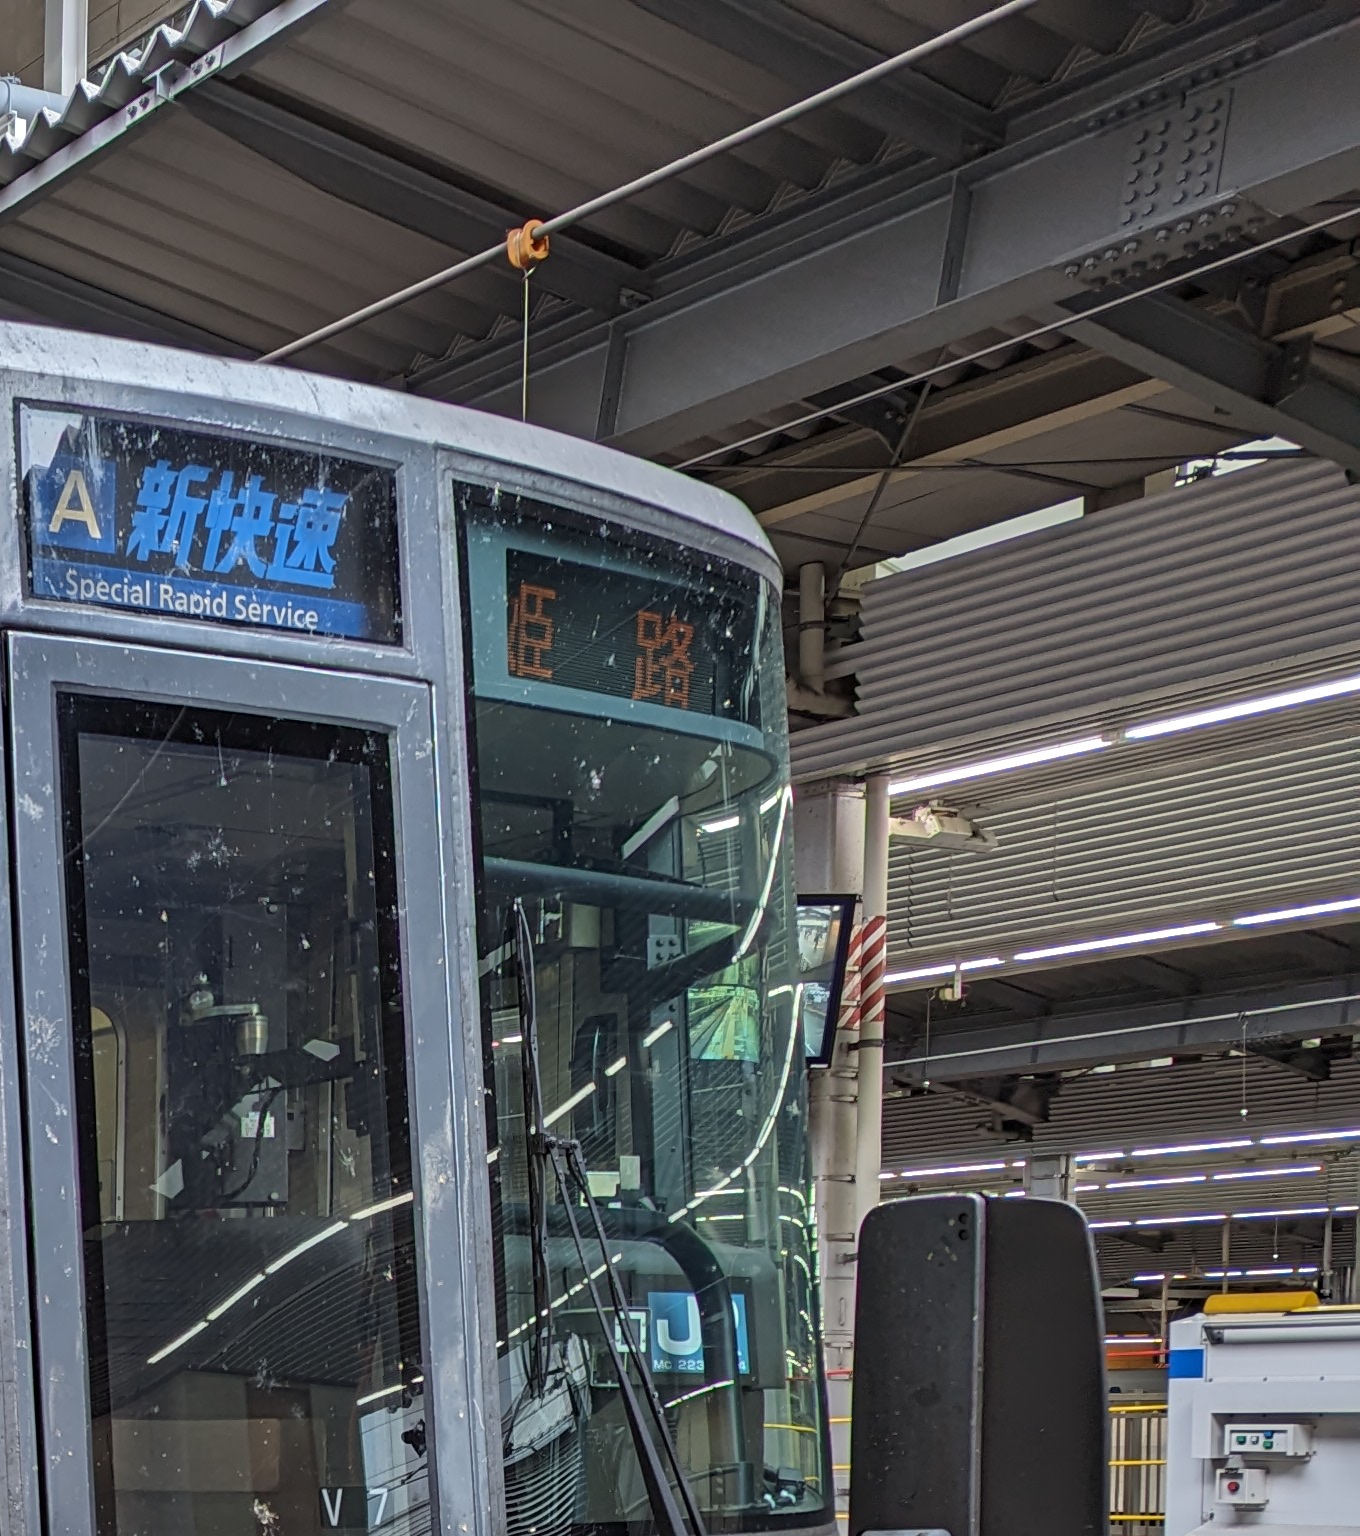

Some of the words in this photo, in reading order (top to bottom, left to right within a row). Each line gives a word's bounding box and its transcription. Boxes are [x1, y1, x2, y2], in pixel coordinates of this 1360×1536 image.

[49, 470, 102, 540] A
[126, 459, 349, 589] 新快速
[66, 571, 151, 607] Special
[159, 583, 228, 617] Rapid
[235, 594, 320, 631] Service
